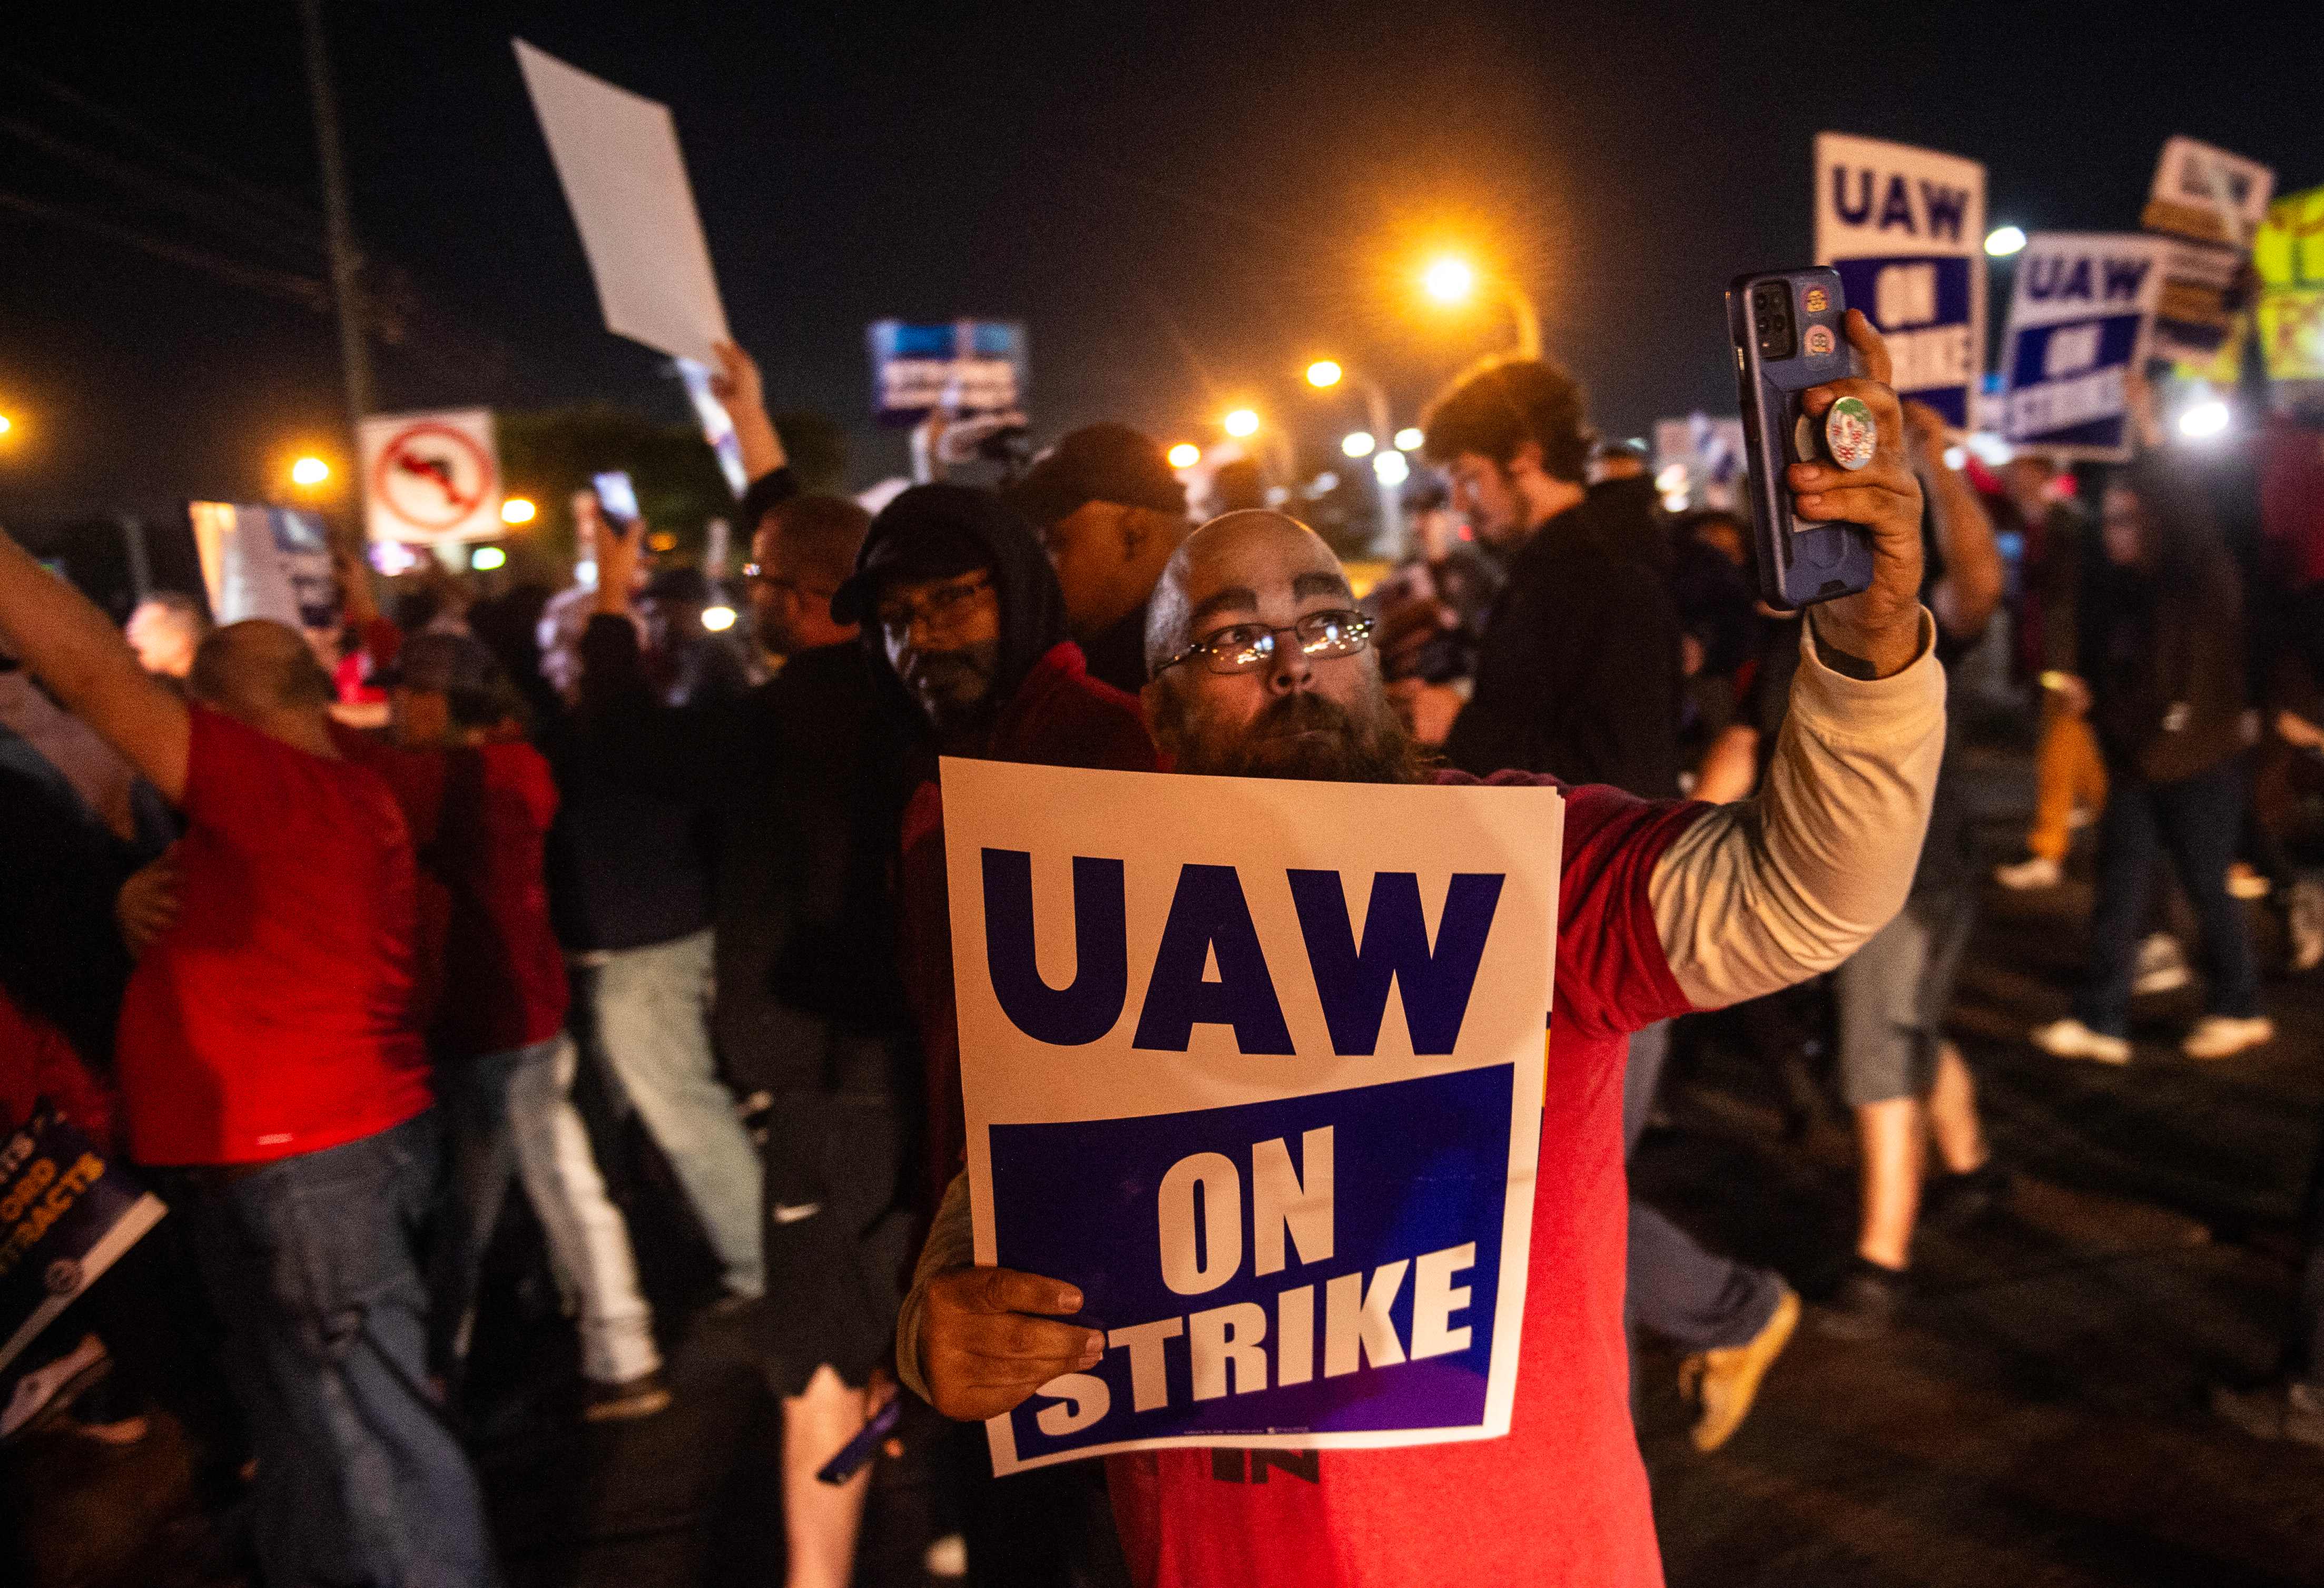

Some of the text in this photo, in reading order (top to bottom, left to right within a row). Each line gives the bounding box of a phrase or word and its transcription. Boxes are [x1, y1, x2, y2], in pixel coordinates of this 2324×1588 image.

[1832, 164, 1969, 241] UAW
[2027, 256, 2152, 300] UAW
[981, 846, 1506, 1057] UAW
[0, 1156, 57, 1222] ORD
[1158, 1124, 1334, 1296] ON
[1035, 1241, 1476, 1437] STRIKE
